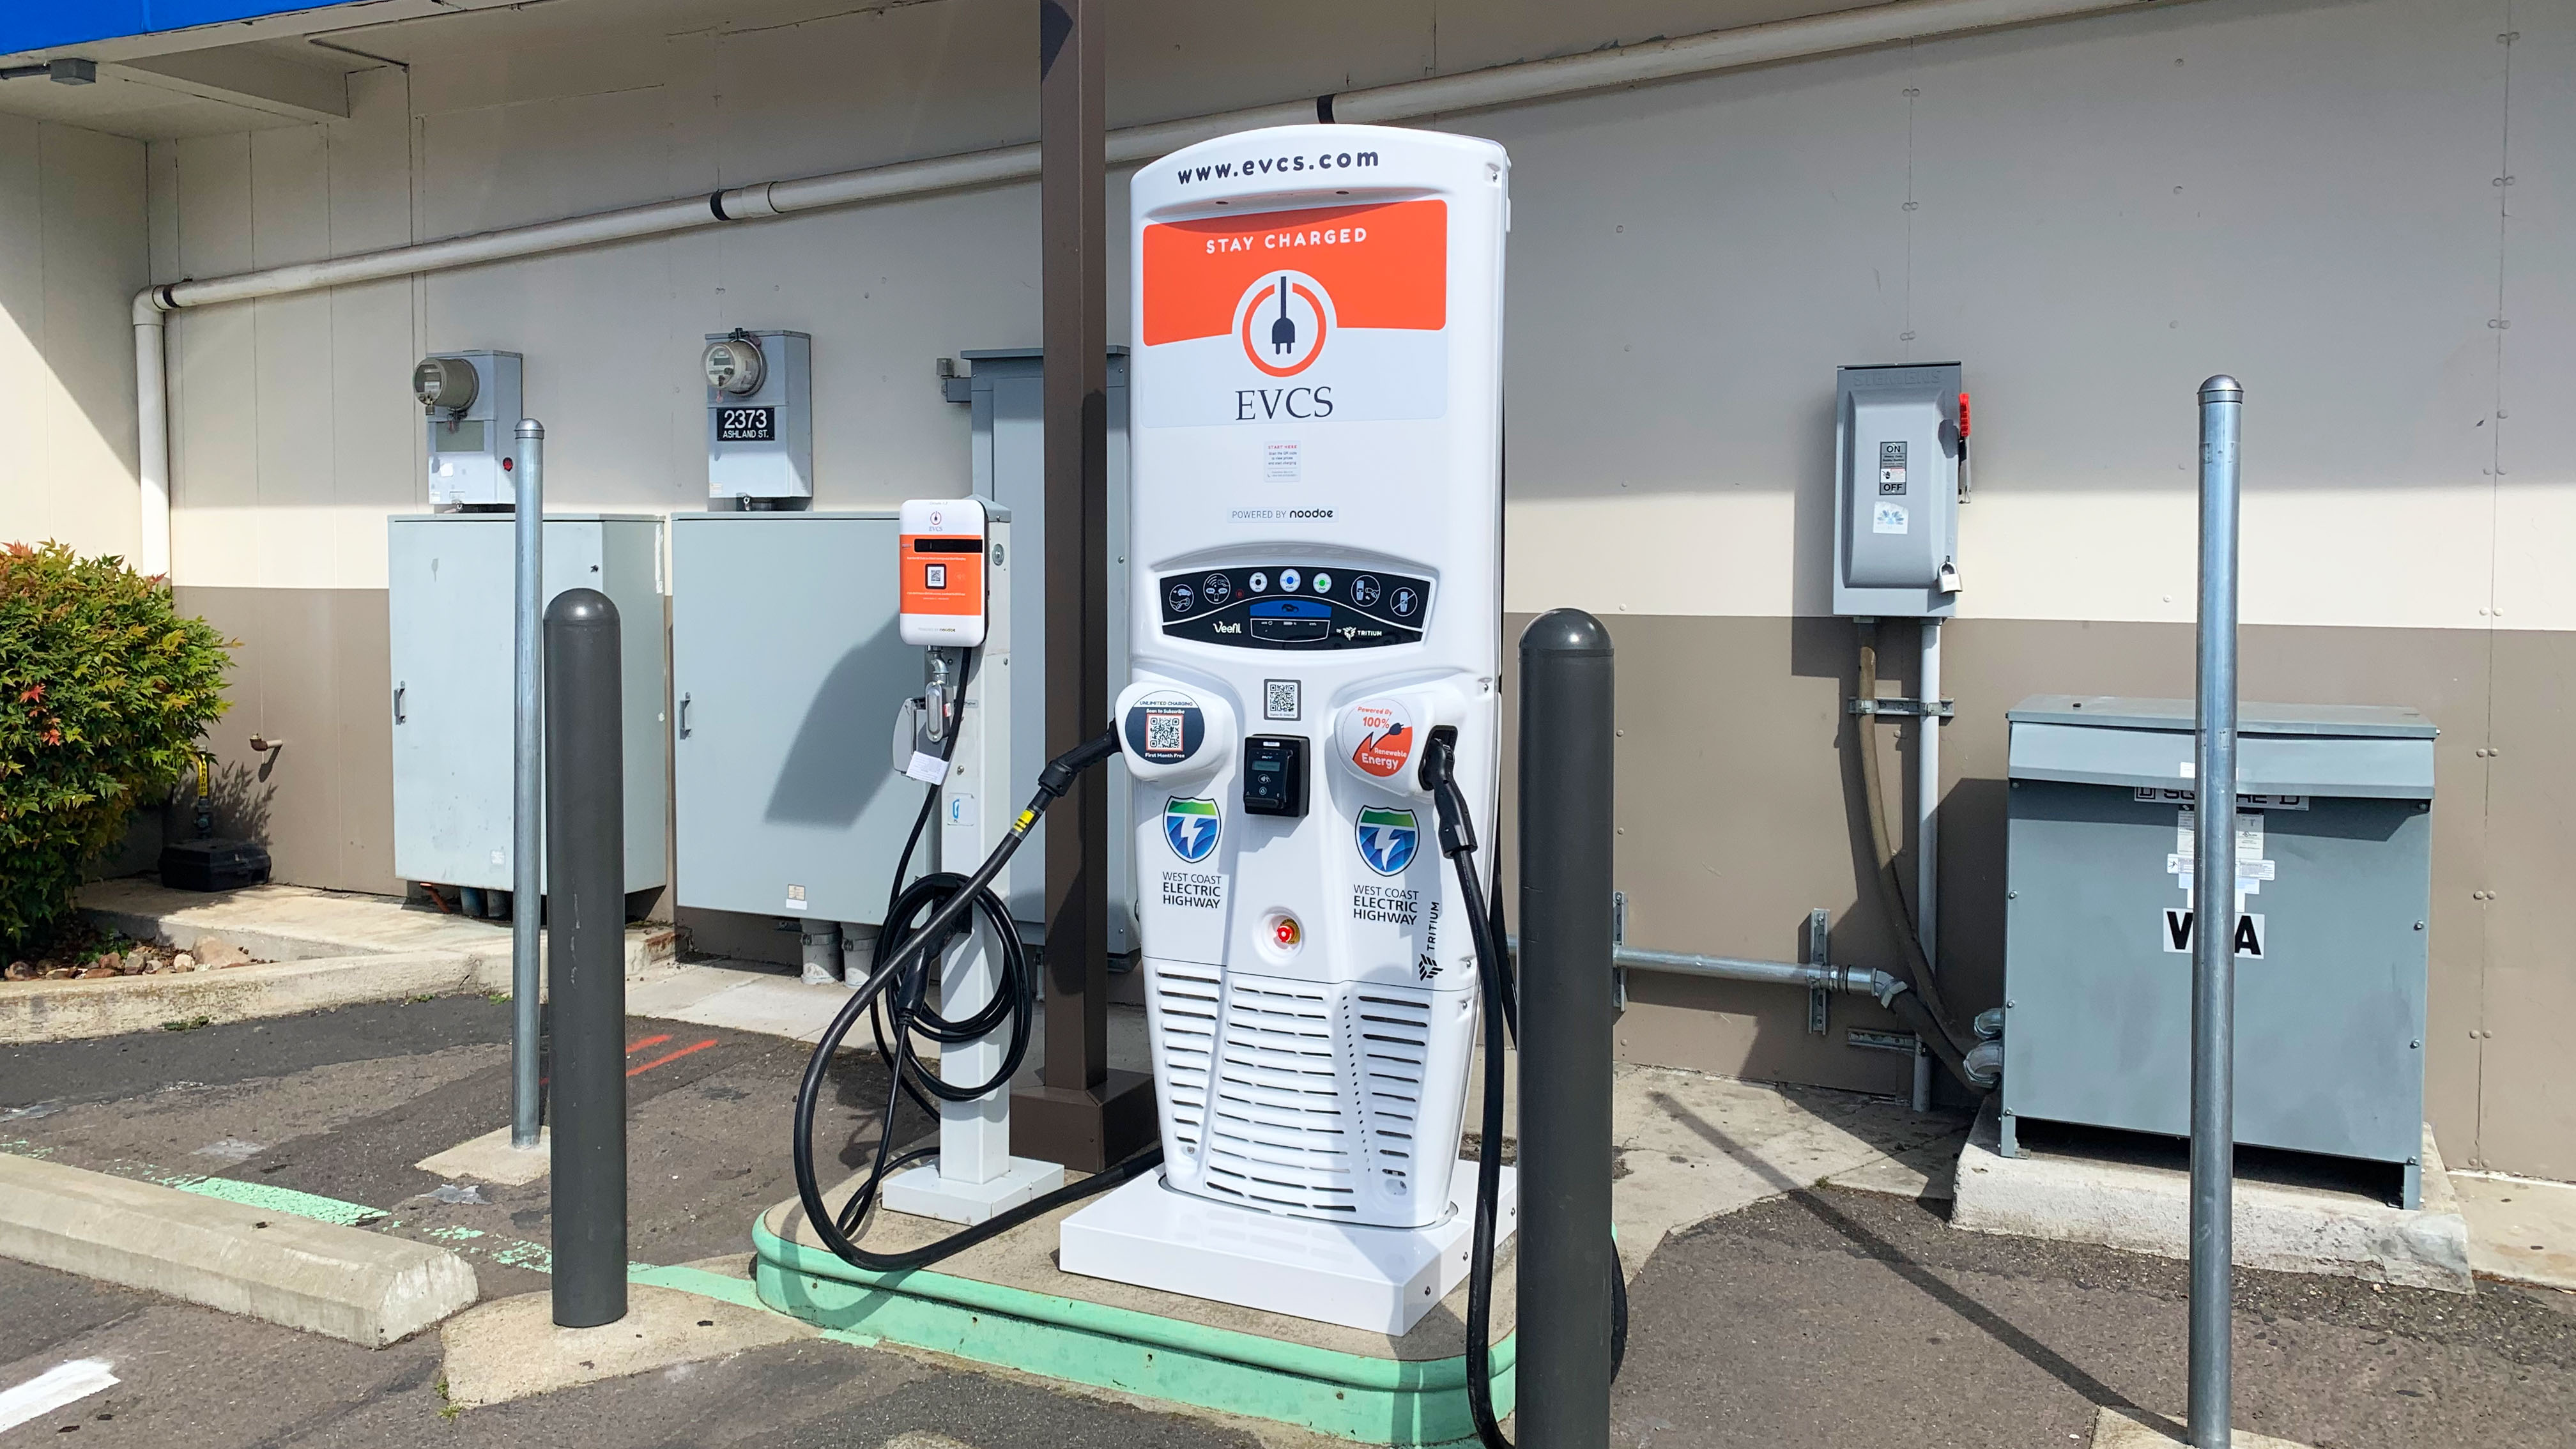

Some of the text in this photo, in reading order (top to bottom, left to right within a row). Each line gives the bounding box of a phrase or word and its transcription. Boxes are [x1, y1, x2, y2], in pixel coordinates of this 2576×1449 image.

[1178, 149, 1379, 185] www.evcs.com
[1206, 227, 1367, 254] STAY CHARGED
[1235, 386, 1333, 421] EVCS
[724, 410, 767, 429] 2373
[723, 429, 769, 438] ASHLAND ST.
[1289, 509, 1333, 518] noodoe
[1213, 621, 1242, 634] Veefil
[1358, 706, 1383, 714] Powered
[1363, 716, 1390, 729] 100%
[1374, 747, 1407, 758] Renewable
[1361, 753, 1399, 770] Energy
[1162, 871, 1222, 884] WEST COAST
[1163, 882, 1220, 897] ELECTRIC
[1353, 884, 1419, 900] WEST COAST
[1163, 894, 1220, 908] HIGHWAY
[1354, 896, 1418, 913] ELECTRIC
[1353, 908, 1417, 925] HIGHWAY
[1427, 901, 1439, 951] TRITIUM
